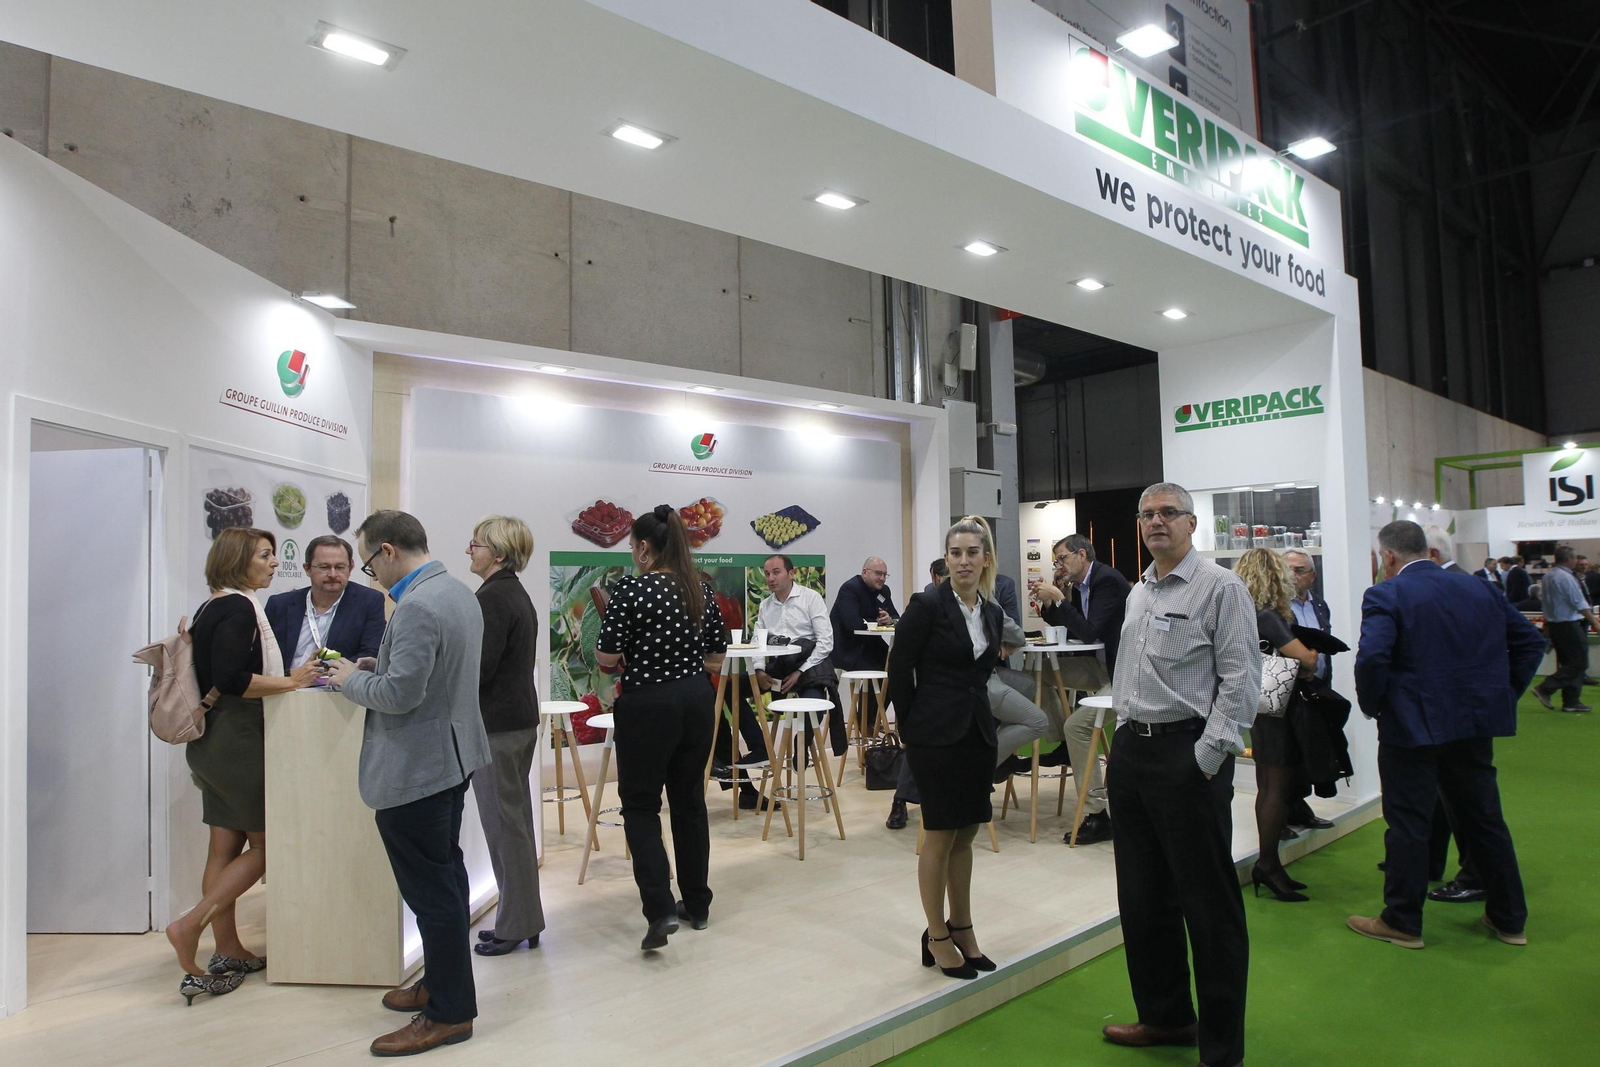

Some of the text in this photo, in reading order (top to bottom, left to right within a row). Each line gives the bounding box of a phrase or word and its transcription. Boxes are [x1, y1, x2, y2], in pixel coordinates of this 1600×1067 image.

[1190, 0, 1232, 32] raction
[1096, 168, 1325, 297] we protect your food
[225, 388, 348, 435] GROUPE GUILLIN PRODUCE DIVISION
[1193, 385, 1323, 422] VERIPACK
[1210, 413, 1284, 428] EMBALAJES
[653, 462, 754, 476] GROUPE GUILLIN PRODUCE DIVISION
[1549, 475, 1594, 507] ISI
[1517, 519, 1555, 529] Research
[282, 561, 297, 571] 100%
[704, 557, 718, 565] your
[719, 556, 733, 564] food
